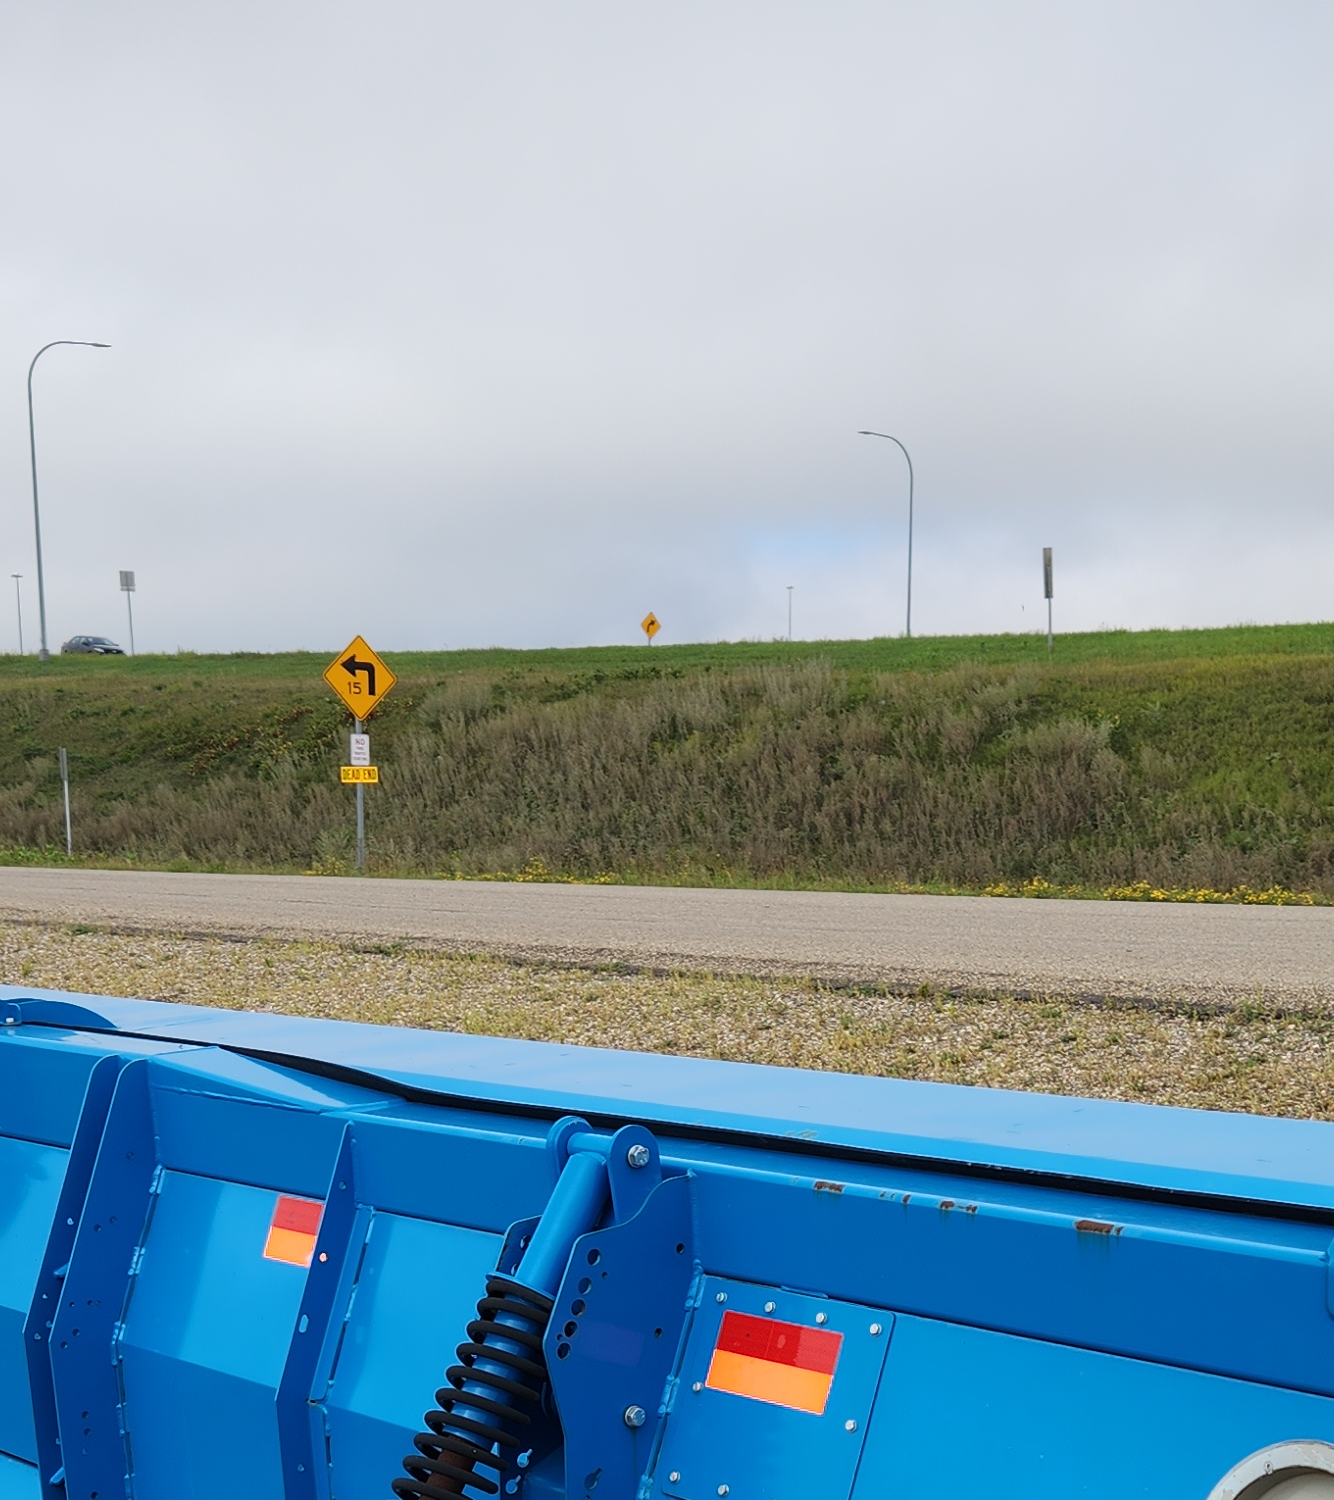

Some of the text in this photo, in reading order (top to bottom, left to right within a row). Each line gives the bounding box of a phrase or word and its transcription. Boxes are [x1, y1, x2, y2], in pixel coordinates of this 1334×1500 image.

[347, 682, 362, 695] 15
[355, 738, 365, 746] NO
[342, 768, 377, 780] DEAD END
